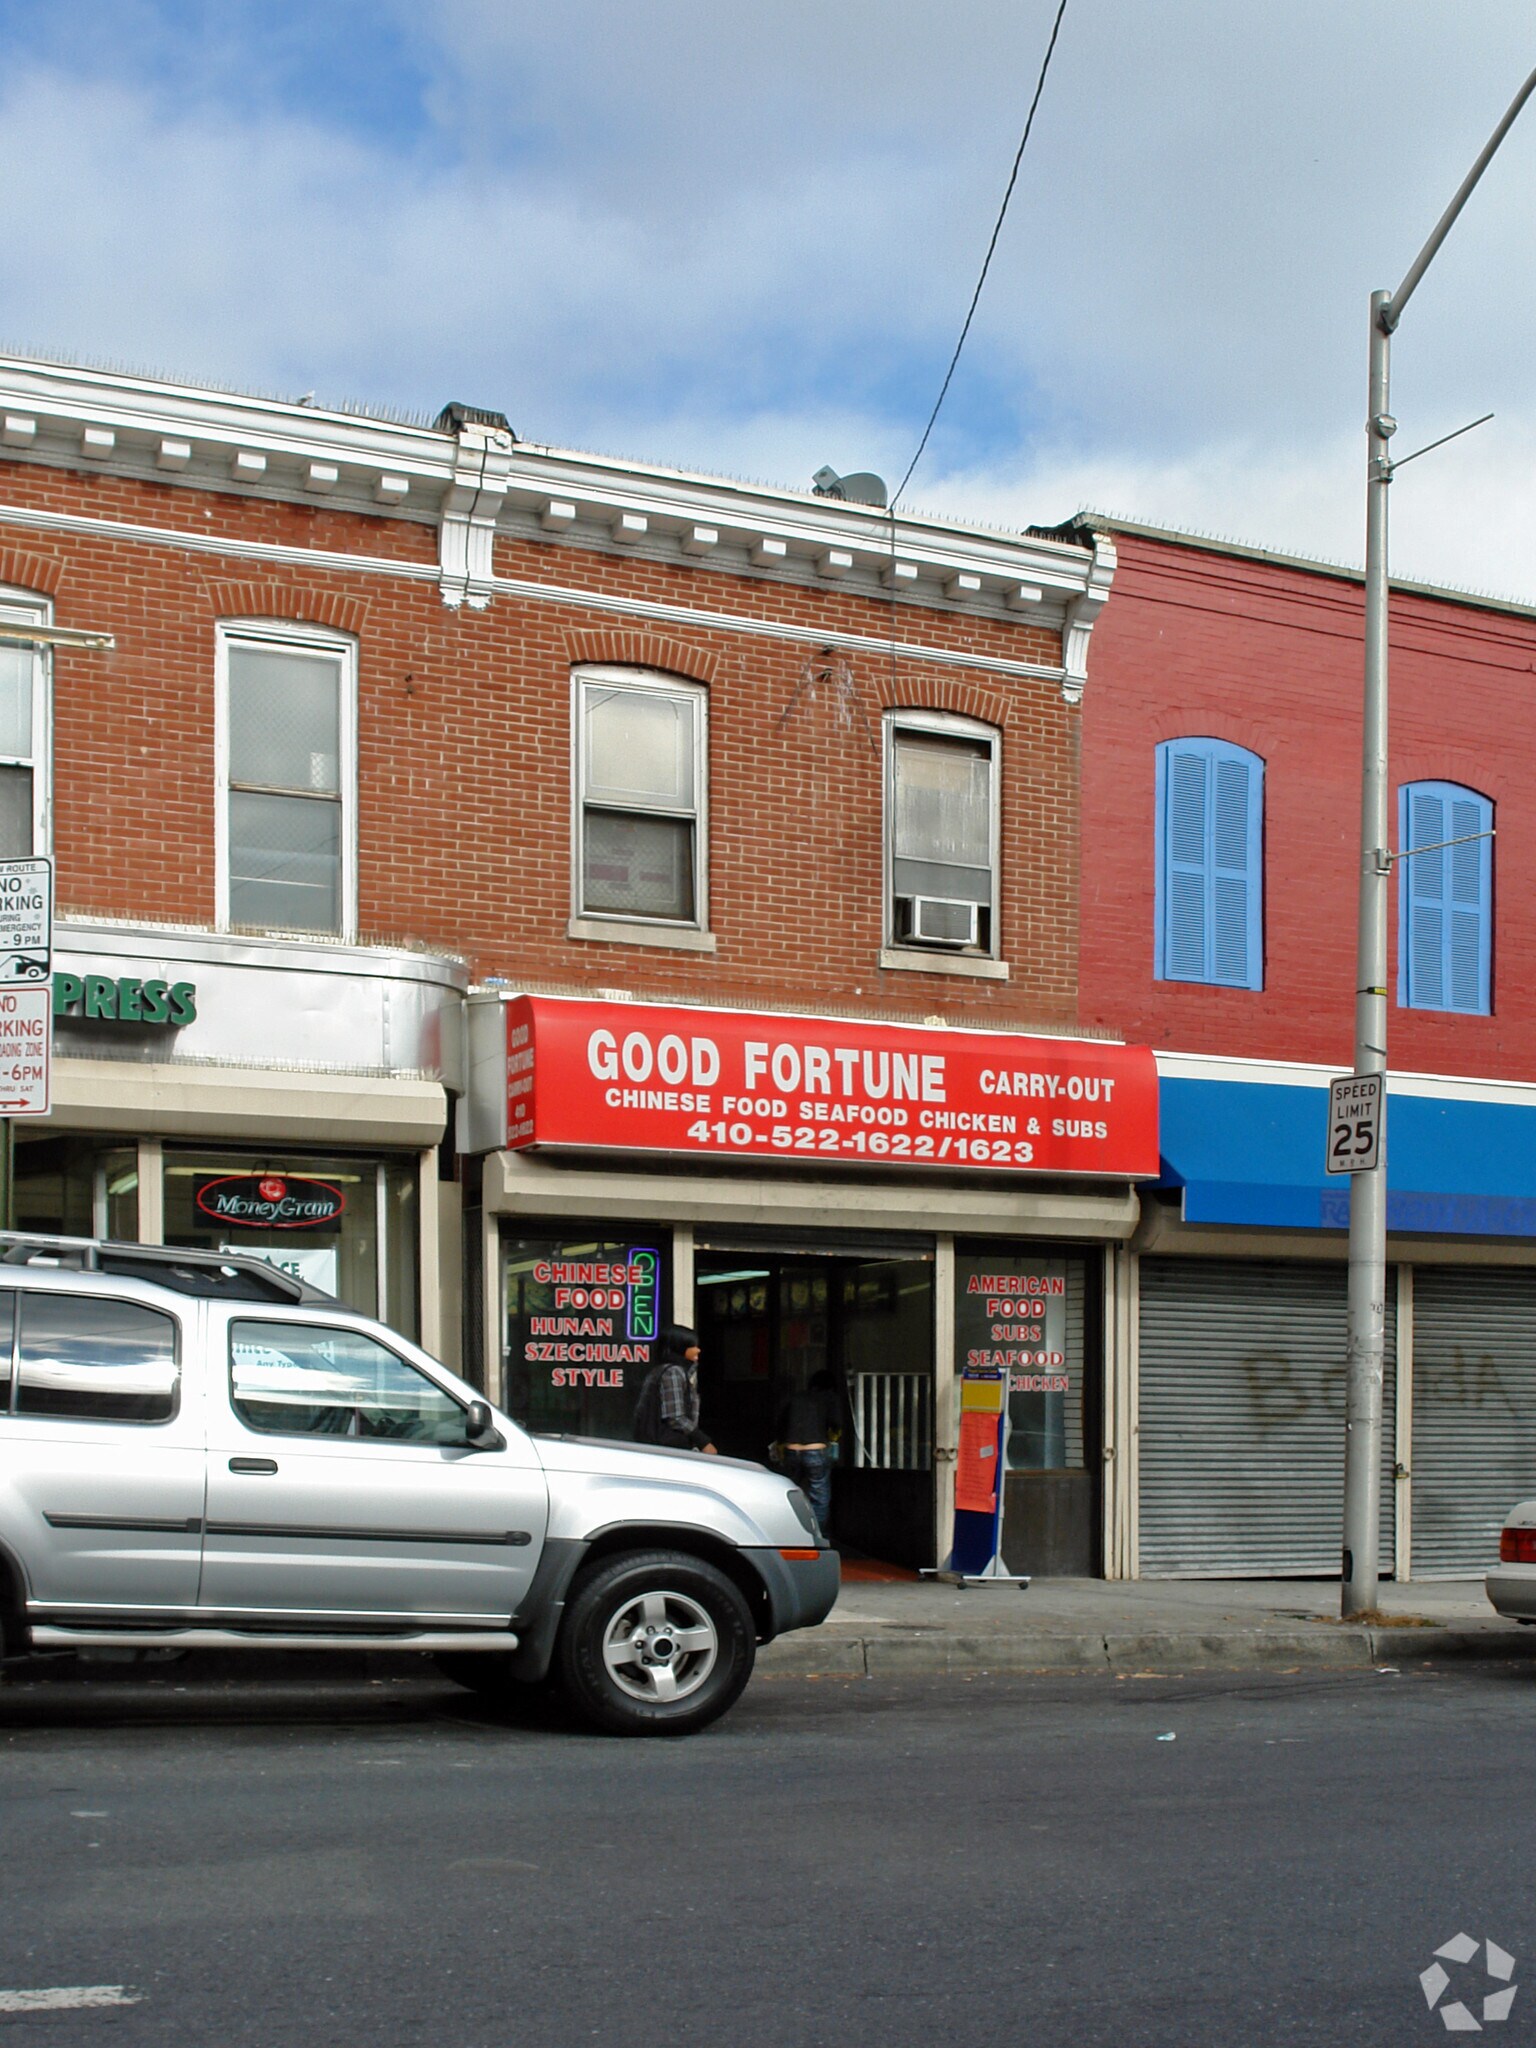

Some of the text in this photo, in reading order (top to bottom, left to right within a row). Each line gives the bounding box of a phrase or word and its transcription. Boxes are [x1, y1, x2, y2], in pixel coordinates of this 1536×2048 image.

[7, 864, 36, 872] ROUTE
[0, 895, 43, 911] KING
[25, 936, 41, 945] PM
[0, 1019, 43, 1037] KING
[25, 1042, 43, 1057] ZONE
[587, 1028, 1115, 1103] GOOD FORTUNE CARRY-OUT
[1336, 1083, 1377, 1101] SPEED
[605, 1087, 1108, 1140] CHINESE FOOD SEAFOOD CHICKEN & SUBS
[1337, 1102, 1373, 1119] LIMIT
[686, 1119, 1034, 1164] 410-522-1622/1623
[1333, 1120, 1374, 1157] 25
[217, 1193, 335, 1221] MoneyGram
[533, 1262, 645, 1284] CHINESE
[633, 1252, 656, 1336] OPEN
[966, 1274, 1065, 1296] AMERICAN
[554, 1288, 626, 1310] FOOD
[986, 1297, 1046, 1319] FOOD
[530, 1316, 613, 1337] HUNAN
[990, 1323, 1041, 1343] SUBS
[524, 1342, 651, 1363] SZECHUAN
[966, 1349, 1065, 1368] SEAFOOD
[551, 1367, 624, 1388] STYLE
[1008, 1374, 1069, 1392] CHICKEN
